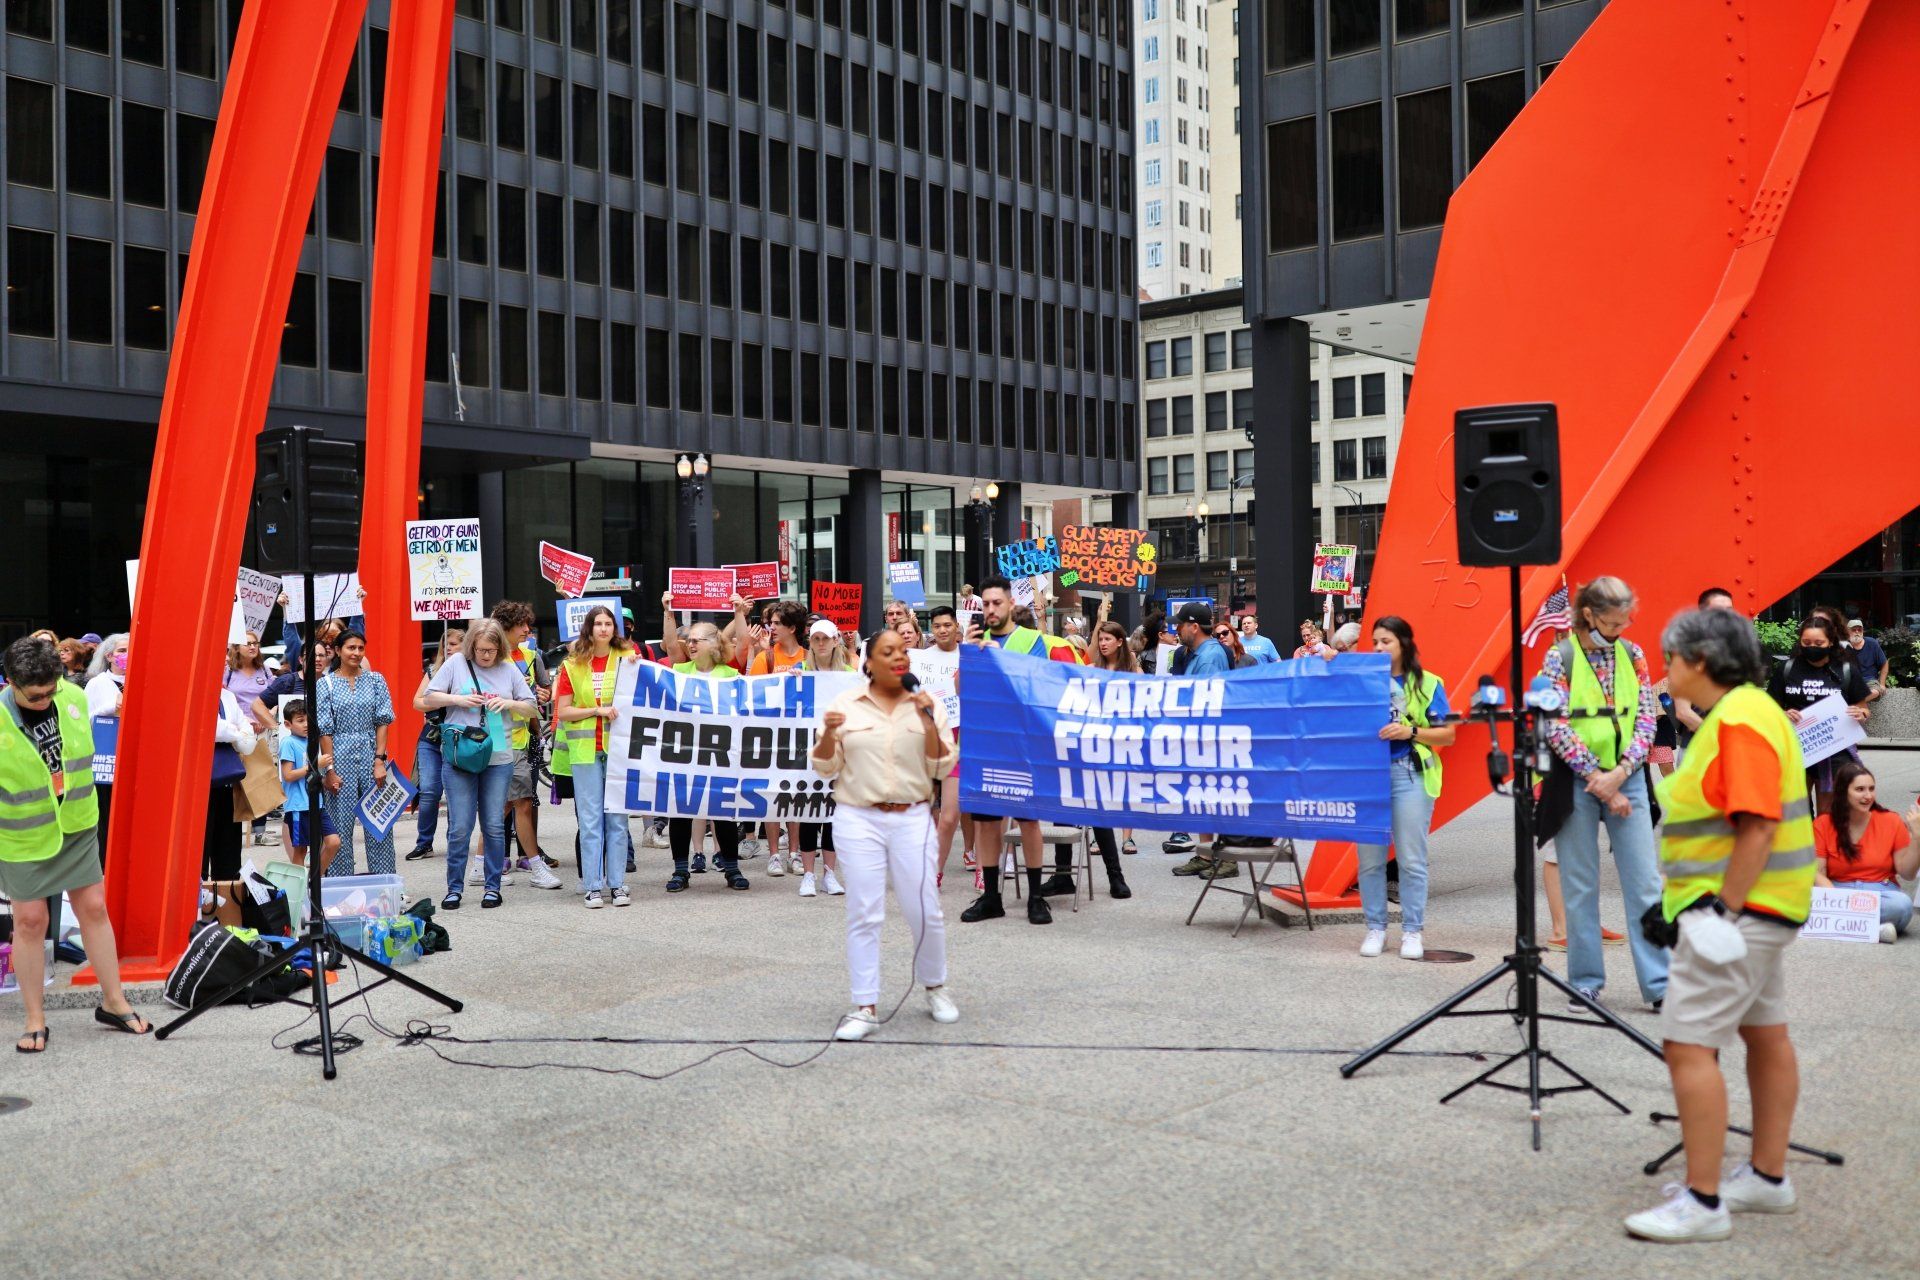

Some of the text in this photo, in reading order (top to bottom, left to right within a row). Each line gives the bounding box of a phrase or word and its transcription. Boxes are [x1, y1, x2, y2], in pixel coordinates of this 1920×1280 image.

[408, 523, 479, 539] GET RID OF GUNS
[1062, 524, 1147, 544] GUN SAFETY
[409, 539, 478, 554] GET RID OF MEN
[1061, 539, 1131, 559] RAISE AGE
[1321, 547, 1339, 555] PROTECT
[562, 568, 580, 579] PUBLIC
[563, 563, 587, 576] PROTECT
[1061, 554, 1157, 575] BACKGROUND
[247, 574, 280, 594] CENTURY
[561, 573, 580, 584] HEALTH
[1079, 570, 1136, 587] CHECKS
[1319, 581, 1346, 589] CHILDREN
[434, 586, 459, 595] PRETTY
[460, 586, 479, 594] CLEAR
[814, 585, 860, 600] NO MORE
[414, 600, 431, 612] WE
[454, 599, 472, 610] HAVE
[244, 615, 266, 633] NTURY
[437, 611, 461, 620] BOTH
[571, 615, 586, 624] FO
[920, 662, 934, 673] THE
[632, 663, 816, 719] MARCH
[1802, 679, 1825, 687] STOP
[1056, 677, 1226, 719] MARCH
[1486, 685, 1499, 705] 9
[1798, 715, 1839, 738] TUDENTS
[628, 716, 818, 770] FOR OU
[1054, 720, 1254, 769] FOR OUR
[1803, 734, 1834, 754] ACTION
[369, 781, 399, 818] FOR OUR
[624, 768, 770, 819] LIVES
[1058, 766, 1184, 815] LIVES
[376, 799, 398, 826] LIVES
[1285, 800, 1357, 818] GIFFORDS
[1809, 891, 1850, 909] rotect
[1802, 917, 1869, 932] NOT GUNS
